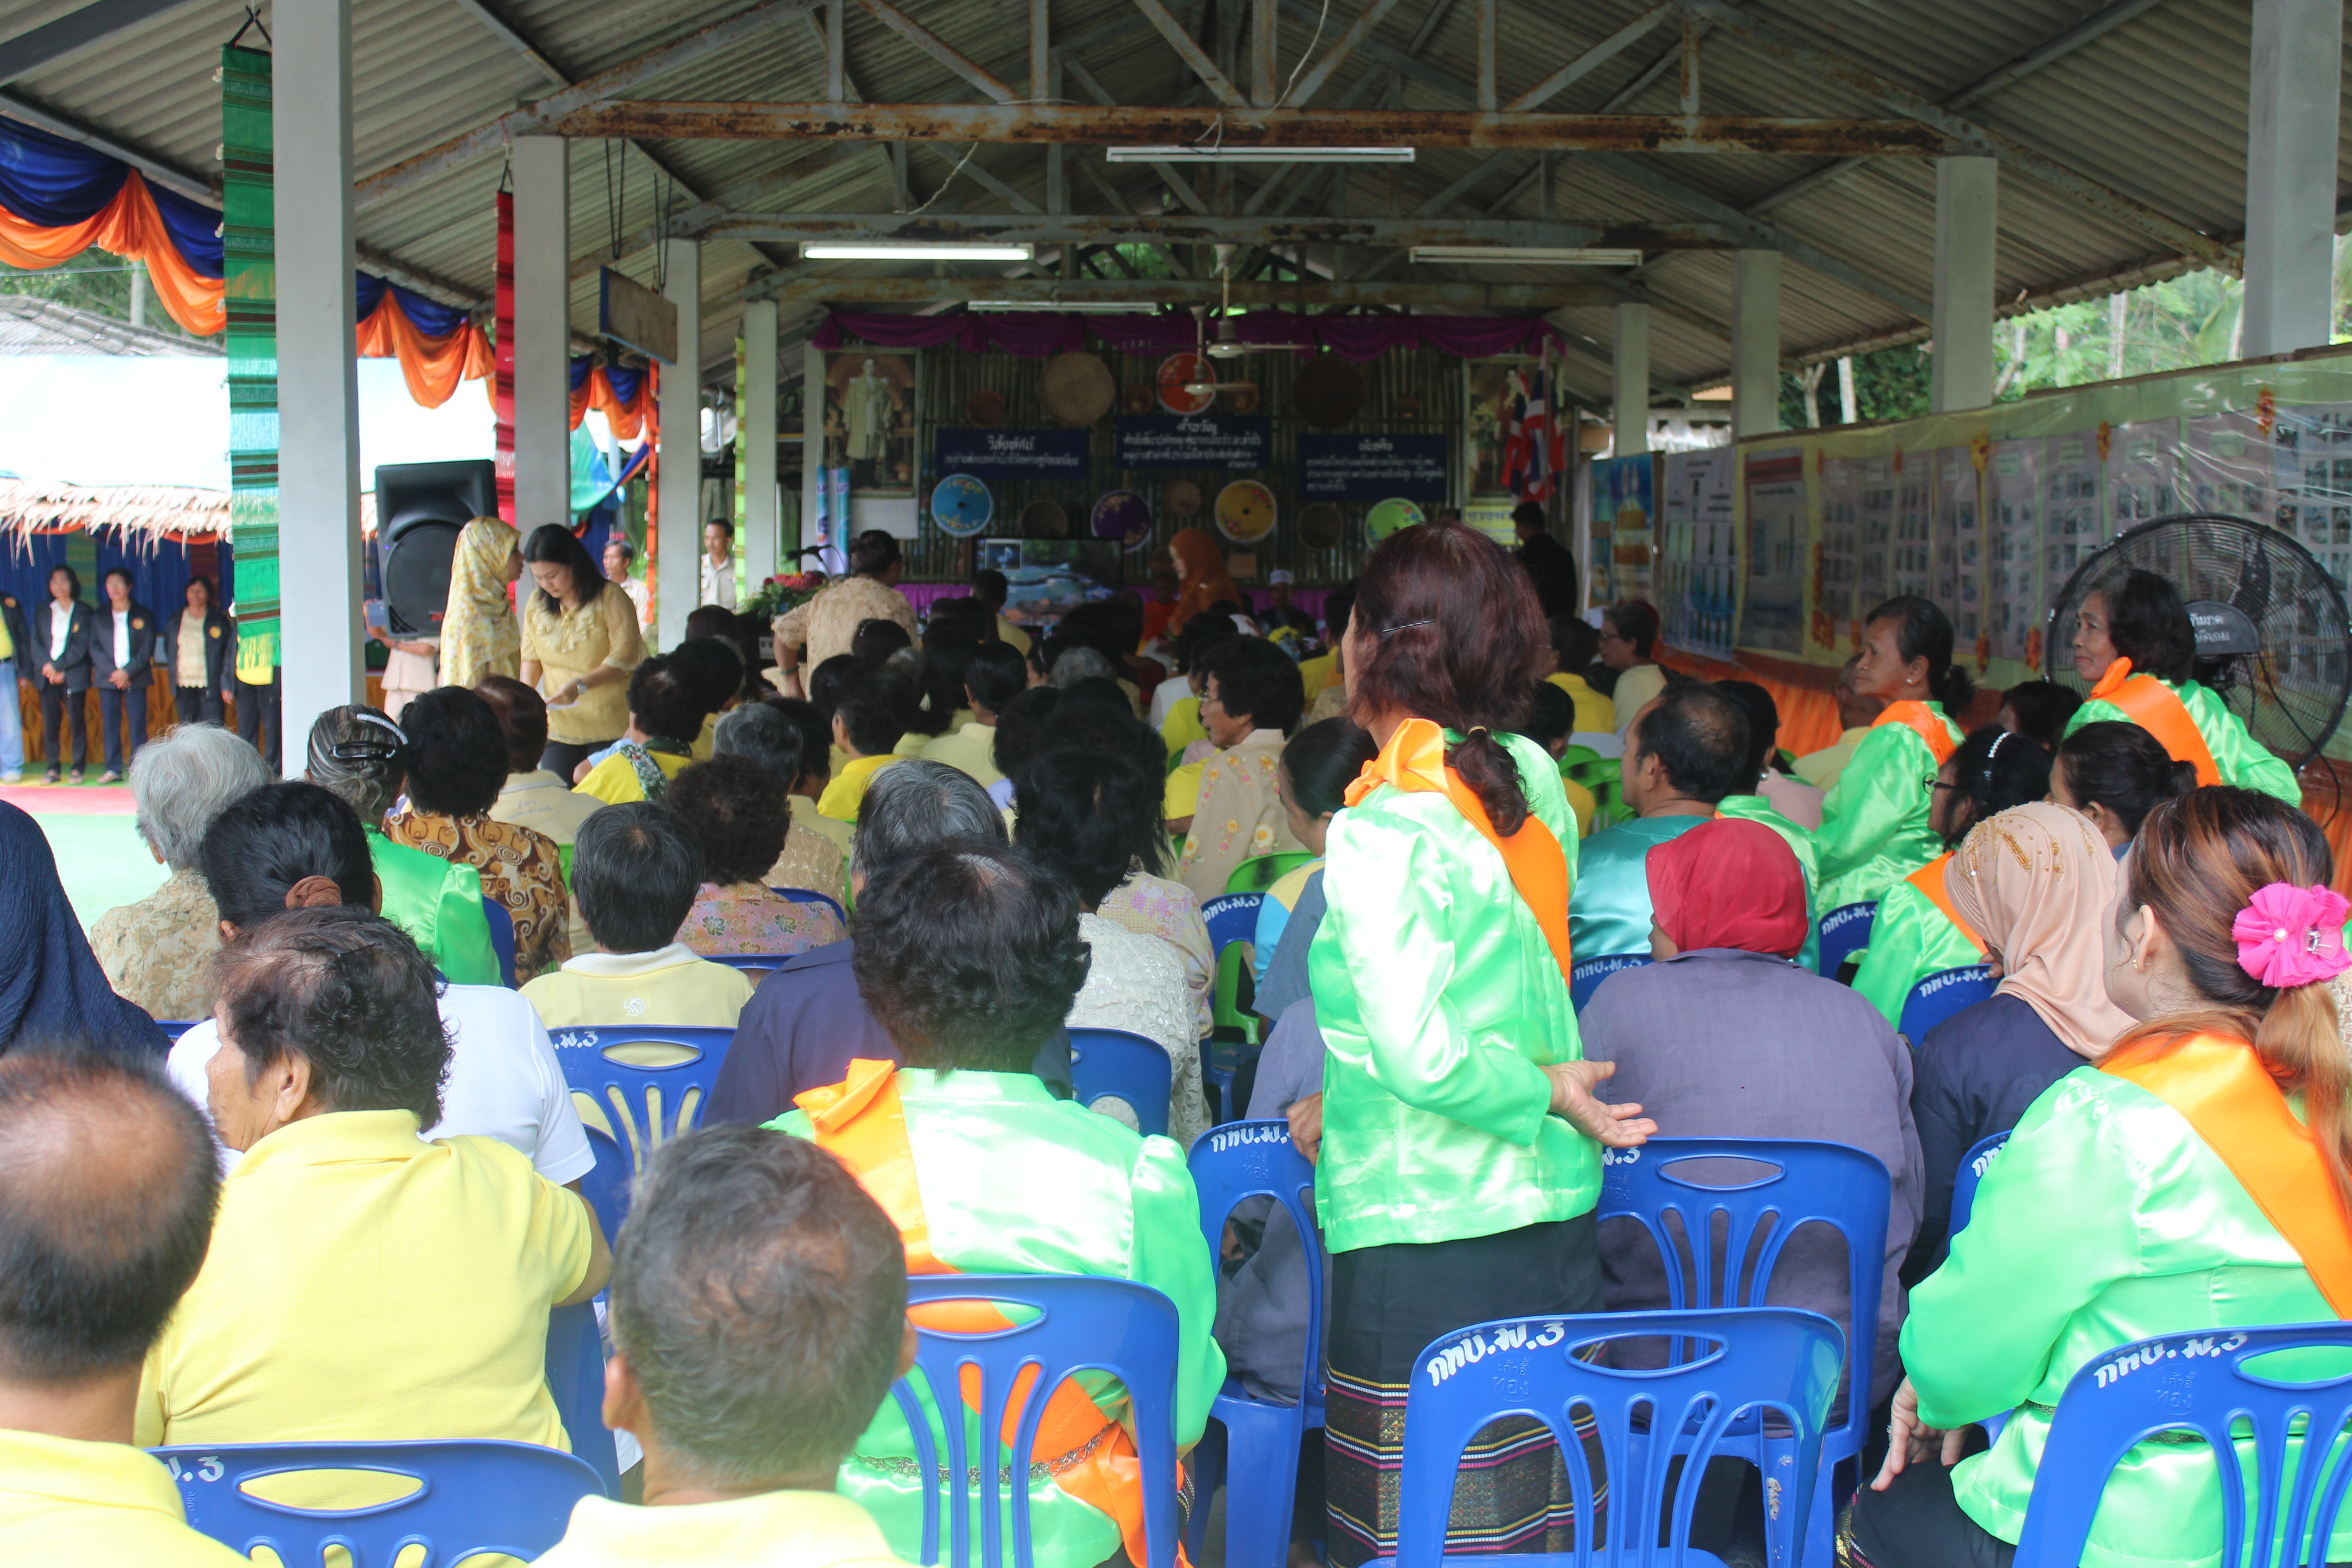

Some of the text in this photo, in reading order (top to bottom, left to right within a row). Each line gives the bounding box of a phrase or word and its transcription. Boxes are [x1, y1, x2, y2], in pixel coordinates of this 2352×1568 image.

[1243, 1164, 1269, 1181] ทอง
[1498, 1357, 1530, 1376] เก้าอี้
[1493, 1376, 1529, 1396] ทอง
[2162, 1370, 2196, 1388] เก้าอี้
[2156, 1389, 2192, 1409] ทอง
